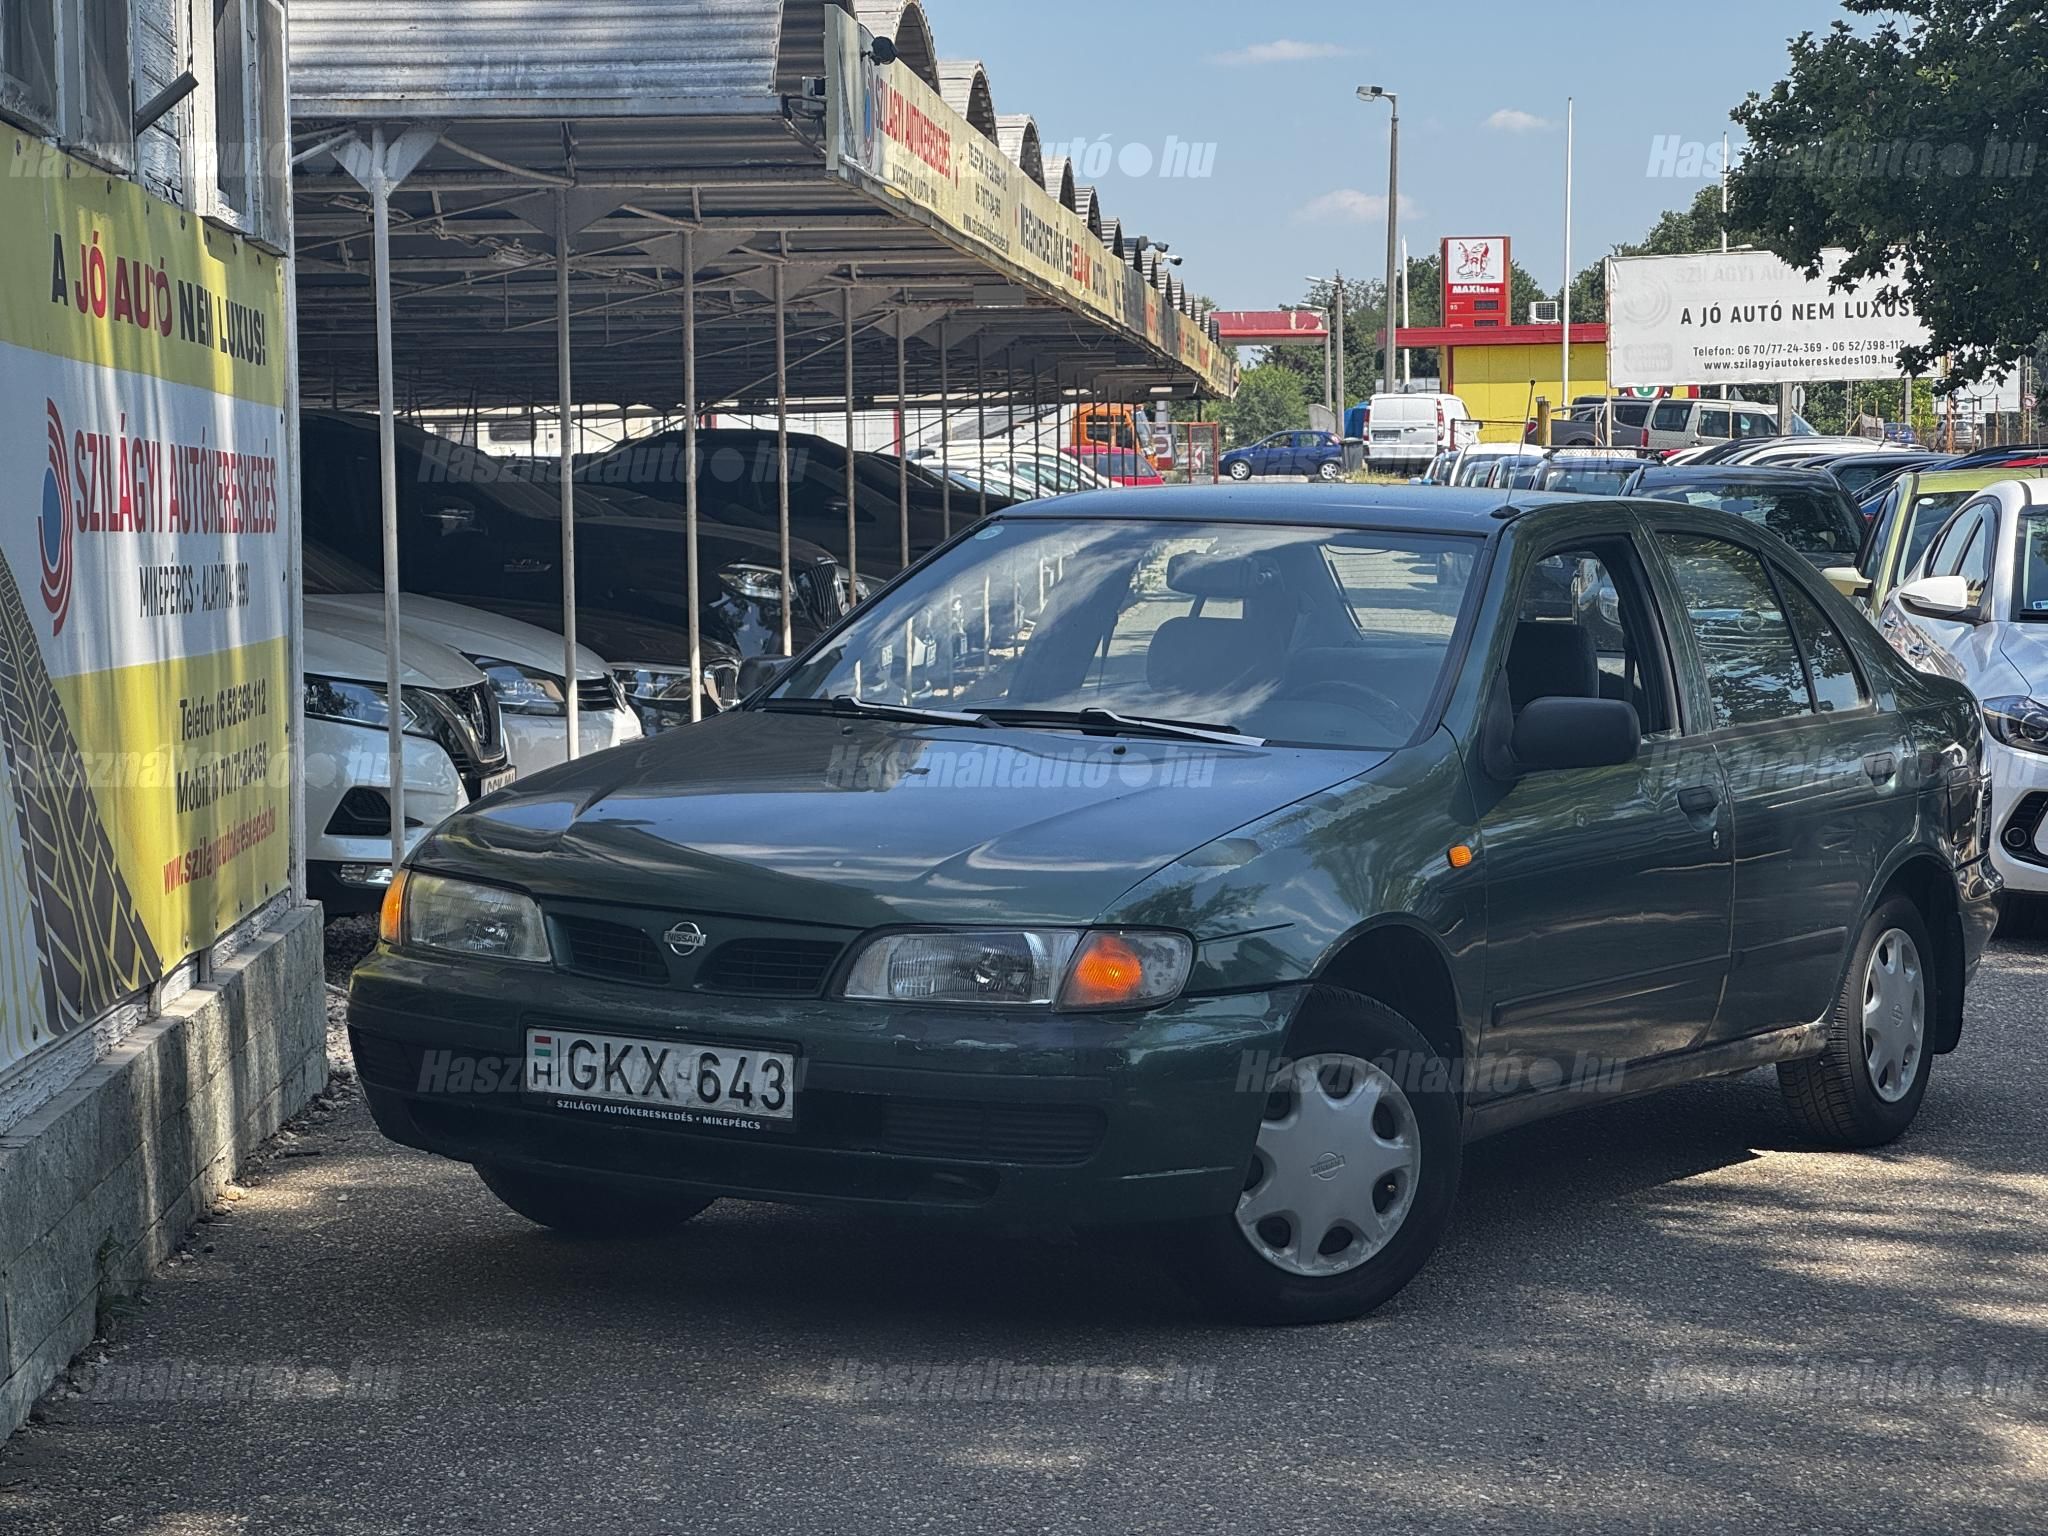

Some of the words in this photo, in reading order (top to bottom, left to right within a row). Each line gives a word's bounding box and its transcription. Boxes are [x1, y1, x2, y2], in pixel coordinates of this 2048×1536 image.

[52, 233, 68, 306] A
[75, 231, 107, 318] JÓ
[114, 257, 172, 337] AUTÓ
[178, 280, 214, 349] NEM
[217, 296, 266, 366] LUXUS!
[1681, 308, 1692, 324] A
[1700, 302, 1721, 327] JÓ
[1730, 300, 1782, 323] AUTÓ
[1792, 303, 1834, 320] NEM
[1693, 346, 1734, 356] Telefon:
[1737, 345, 1750, 355] 06
[1753, 343, 1822, 355] 70/77-24-369
[1832, 341, 1845, 351] 06
[1848, 340, 1905, 351] 52/398-112
[1704, 354, 1894, 370] www.szilagyiautokereskedes109.hu
[75, 413, 162, 533] SZILÁGYI
[169, 426, 277, 535] AUTÓKERESKEDÉS
[139, 552, 194, 618] MIKEPÉRCS
[667, 933, 701, 943] NISSAN
[533, 1061, 551, 1087] H
[556, 1099, 601, 1113] SZILÁGYI
[603, 1105, 693, 1123] AUTÓKERESKEDÉS
[702, 1115, 761, 1130] MIKEPÉRCS
